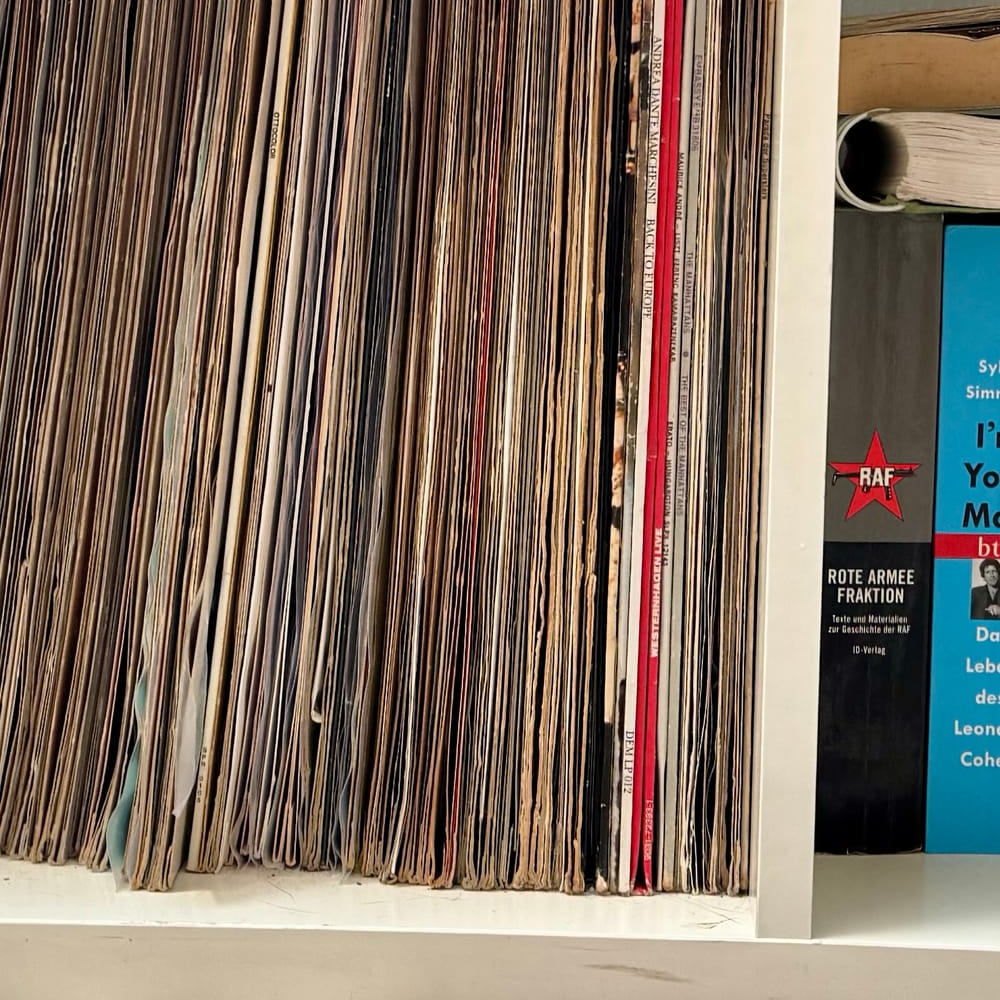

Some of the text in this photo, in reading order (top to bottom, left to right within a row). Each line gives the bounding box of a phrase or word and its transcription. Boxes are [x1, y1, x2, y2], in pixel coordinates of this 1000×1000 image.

[692, 54, 703, 101] EMBASSY
[642, 36, 663, 320] ANDREA DANTE MARCHESINI BACK TO EUROPE
[676, 152, 685, 189] MAURICE
[683, 251, 694, 334] THE MANHATTANS
[676, 375, 689, 517] THE BEST OF THE MANHATTANS
[858, 466, 895, 488] RAF
[649, 527, 663, 658] WESTERNHAGEN LIVE
[828, 568, 915, 585] ROTE ARMEE
[837, 587, 905, 604] FRAKTION
[828, 625, 911, 634] zur Geschichte der RAF
[832, 614, 908, 624] Texte und Materialien
[852, 645, 886, 656] ID-Verlag
[623, 730, 634, 795] DEM LP 012
